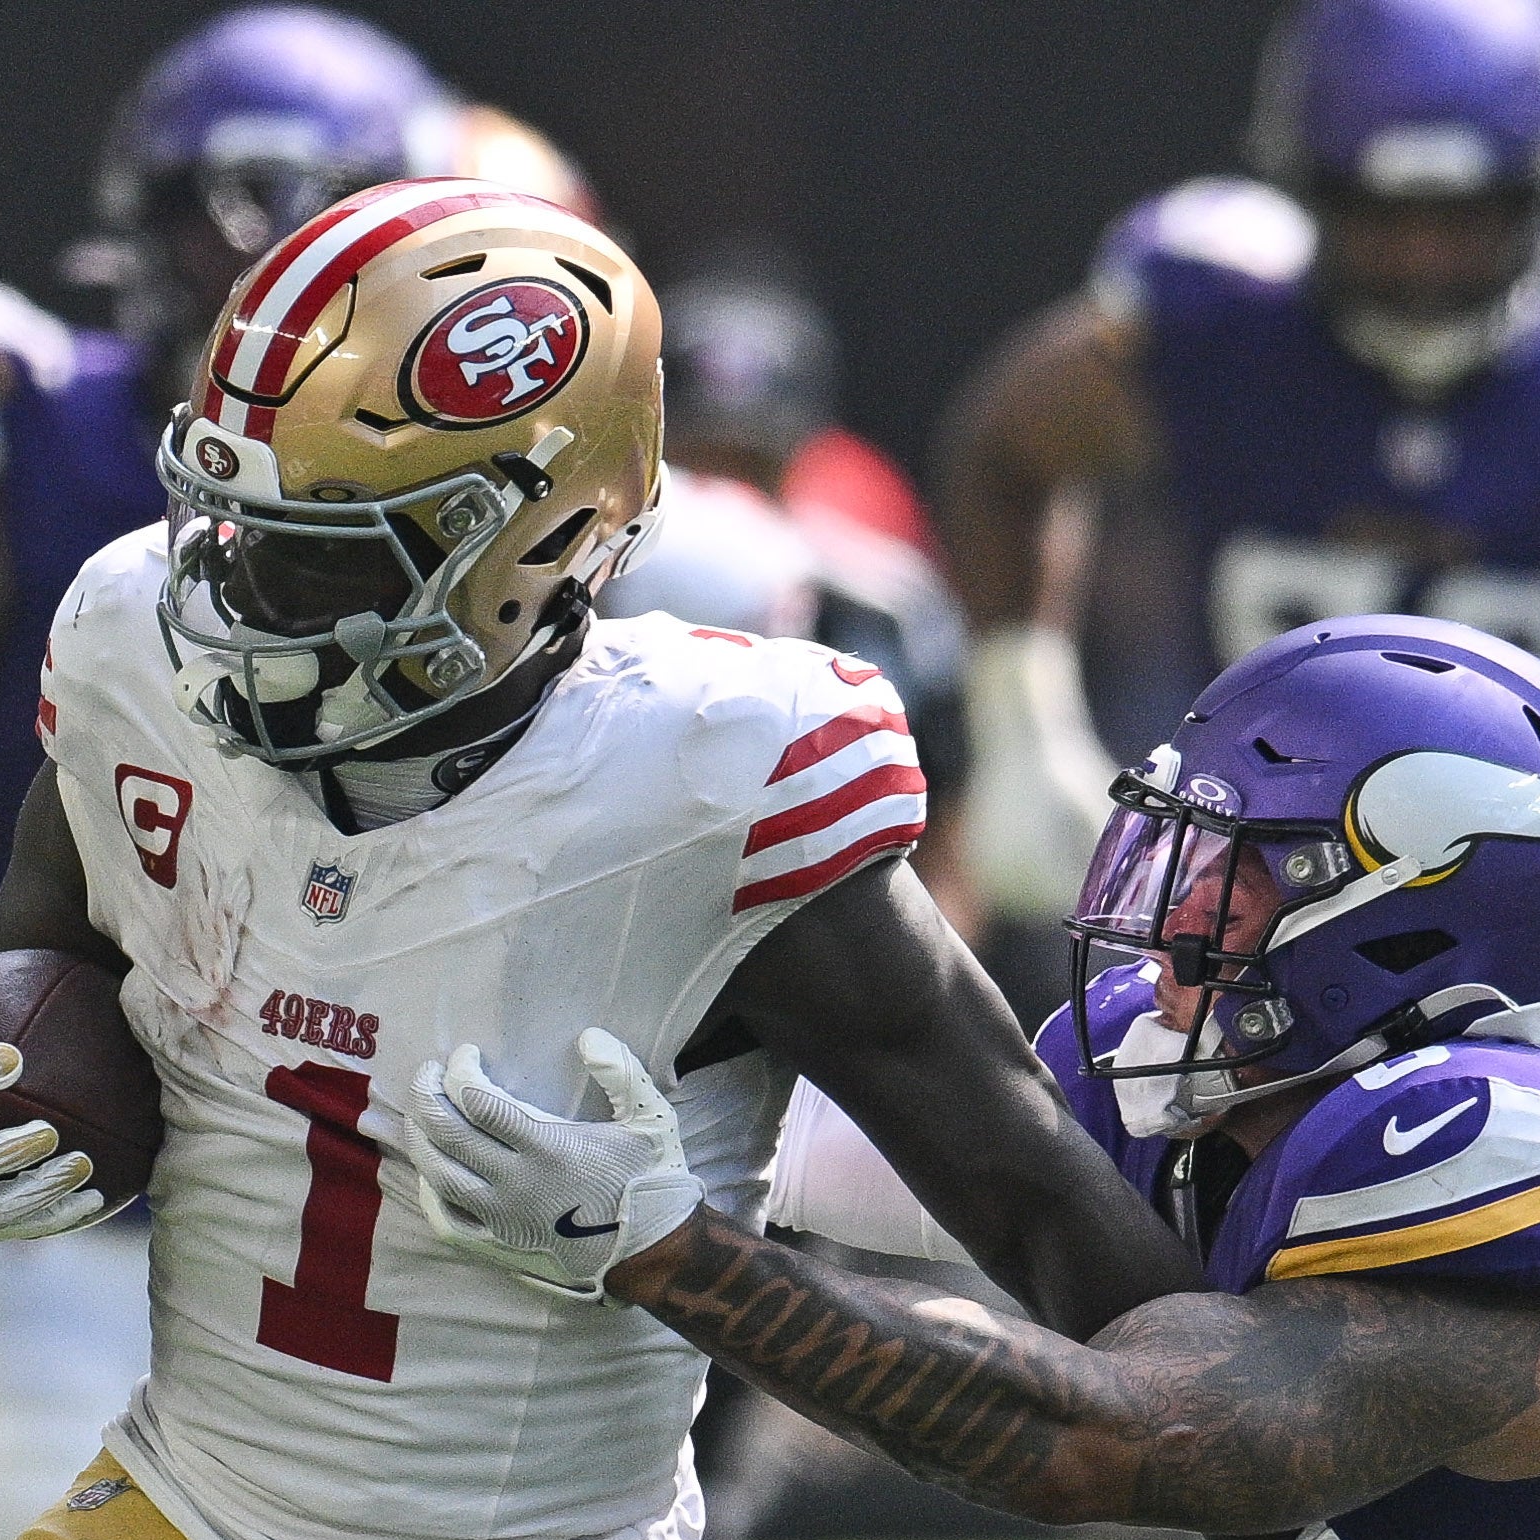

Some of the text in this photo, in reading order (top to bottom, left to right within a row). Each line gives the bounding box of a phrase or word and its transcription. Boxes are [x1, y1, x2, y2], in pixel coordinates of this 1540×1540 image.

[447, 296, 564, 406] SF
[121, 775, 180, 856] C
[1179, 790, 1233, 817] OAKLEY
[307, 883, 340, 914] NFL
[259, 988, 379, 1059] 49ERS
[256, 1060, 400, 1383] 1
